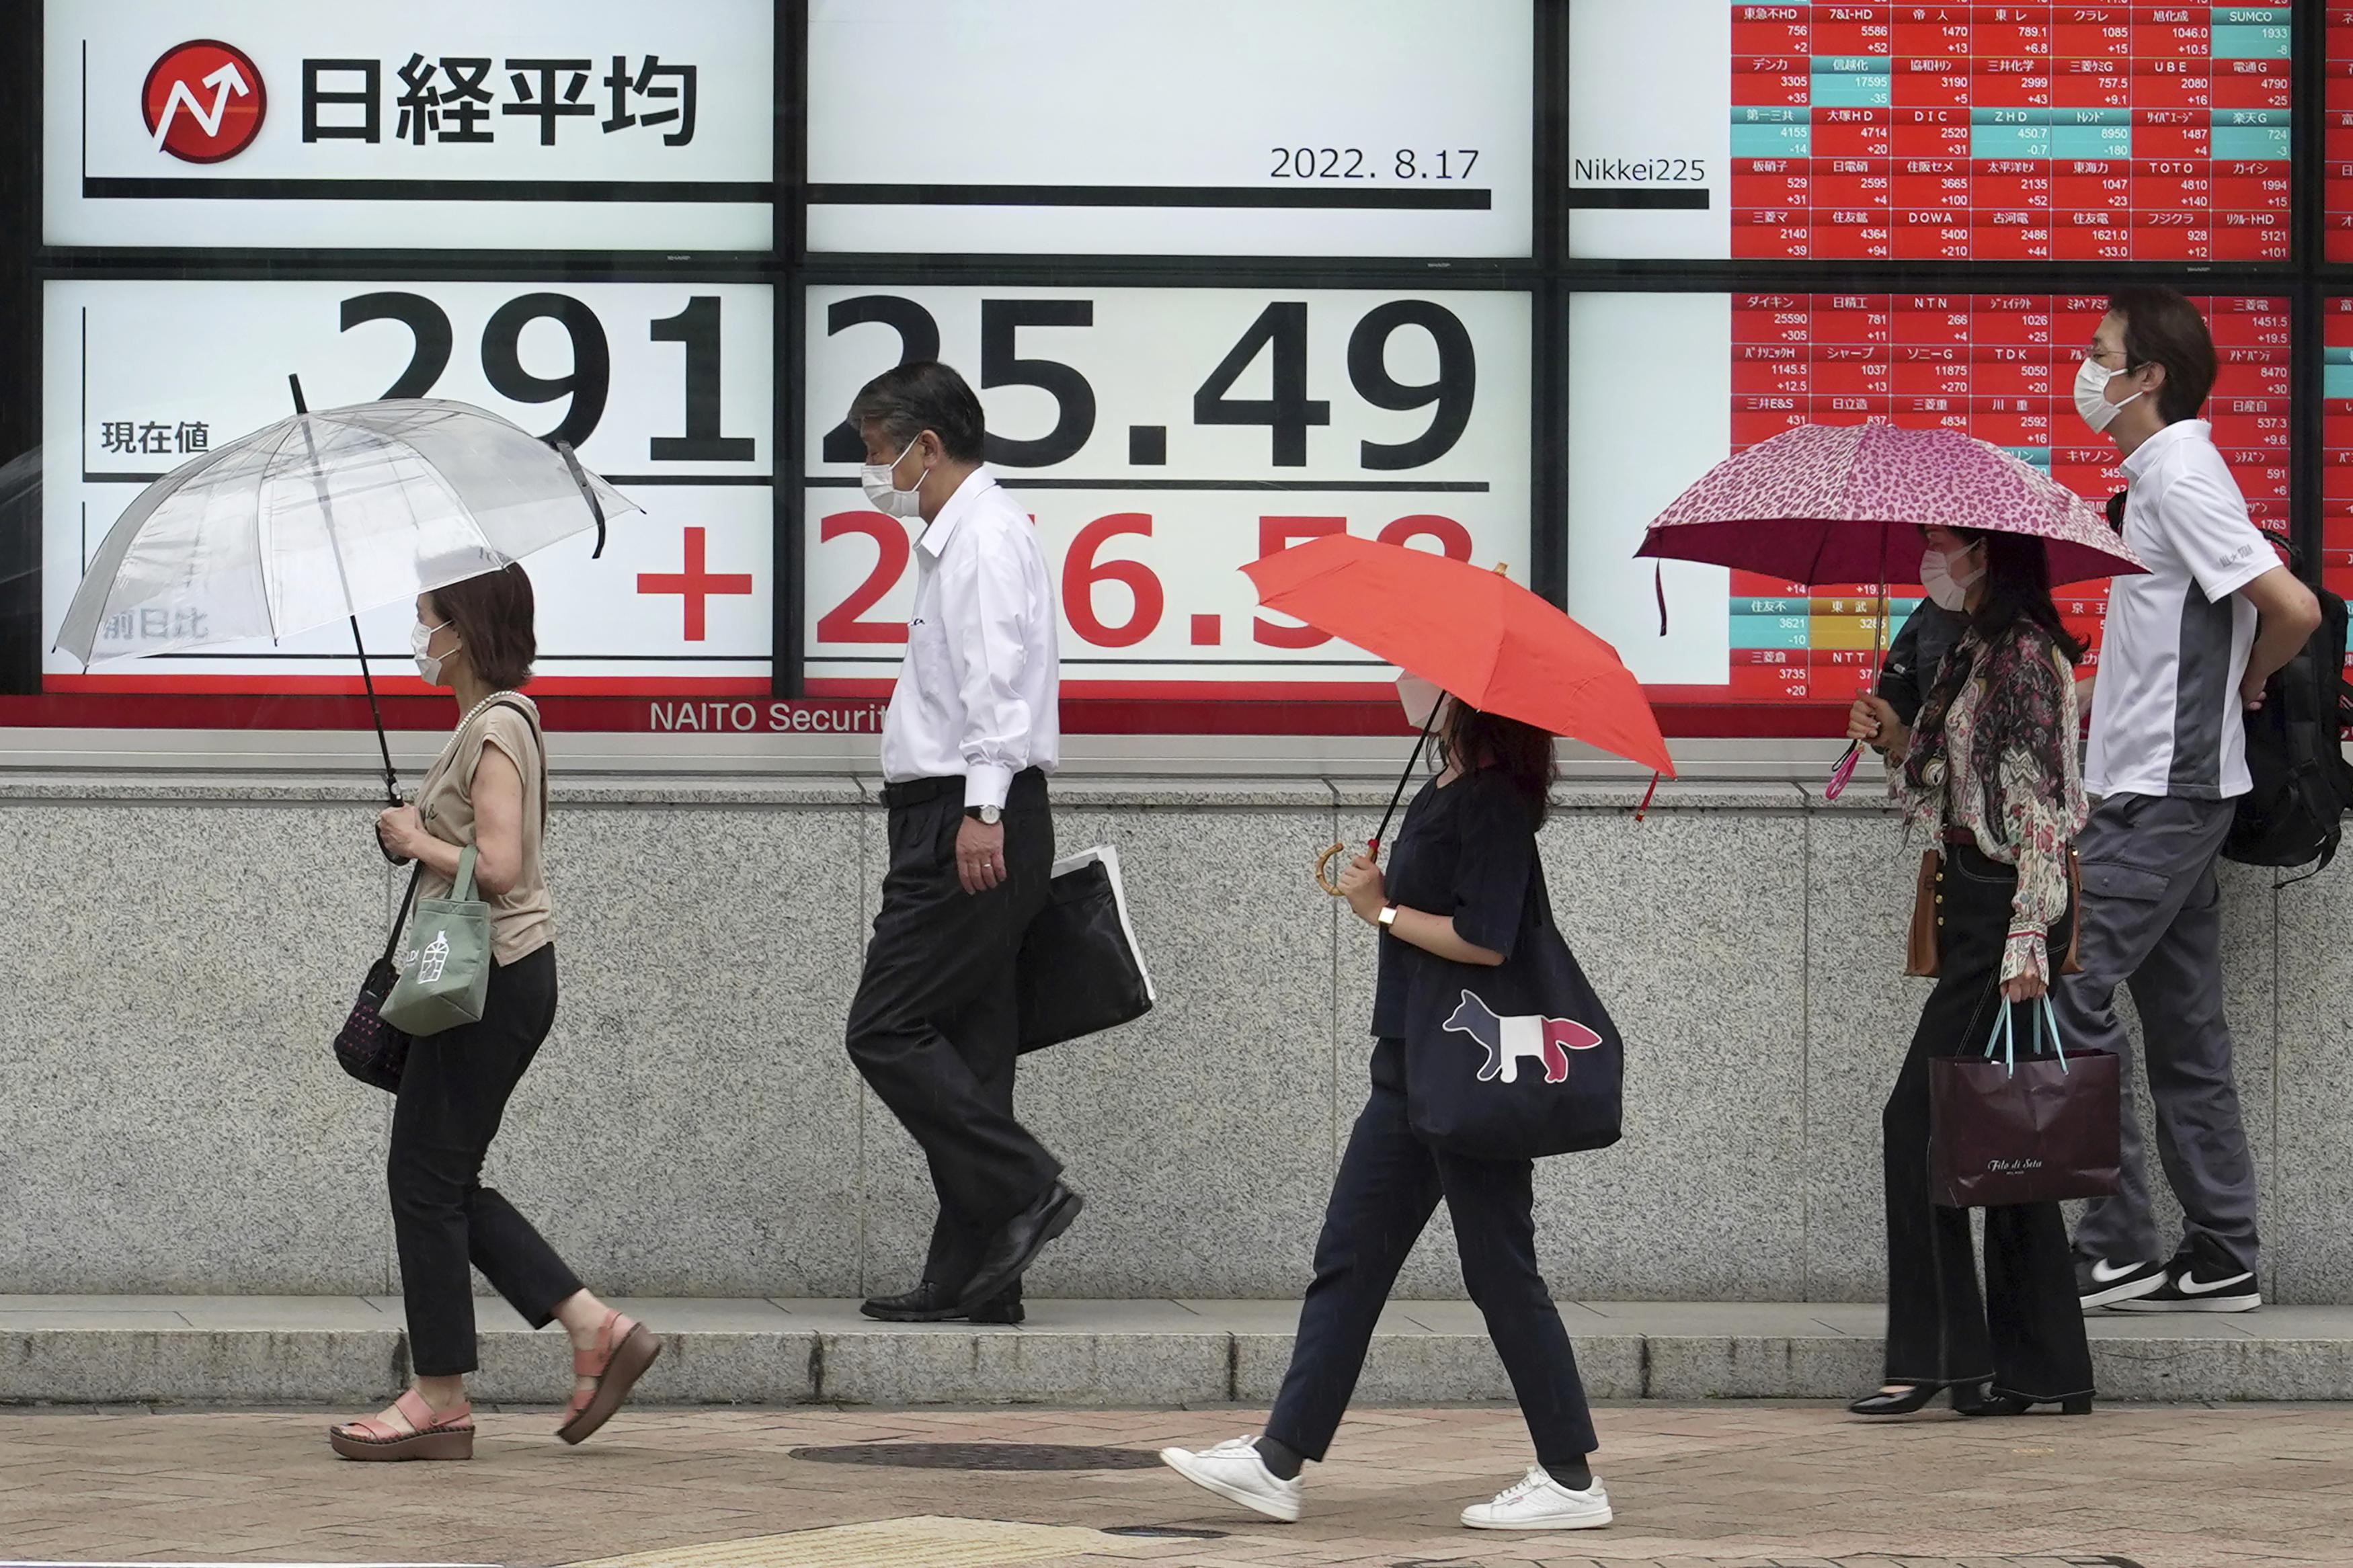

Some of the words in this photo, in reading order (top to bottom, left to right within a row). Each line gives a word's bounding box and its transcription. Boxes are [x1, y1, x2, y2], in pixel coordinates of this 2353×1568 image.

[1829, 8, 1873, 19] 7&I-HD
[2229, 10, 2272, 22] SUMCO
[1787, 25, 1808, 36] 756
[1861, 26, 1888, 36] 5586
[1942, 26, 1968, 37] 1470
[2018, 26, 2046, 37] 789.1
[2102, 27, 2128, 38] 1085
[2172, 27, 2208, 38] 1046.0
[2262, 28, 2288, 38] 1933
[1794, 42, 1808, 52] +2
[1868, 42, 1888, 53] +52
[1948, 42, 1968, 54] +13
[2024, 42, 2048, 54] +6.8
[2108, 43, 2128, 54] +15
[2178, 44, 2208, 55] +10.5
[1781, 76, 1808, 87] 3305
[1855, 76, 1888, 87] 17595
[1941, 77, 1968, 88] 3190
[2021, 77, 2048, 88] 2999
[2098, 77, 2128, 89] 757.5
[2181, 78, 2208, 89] 2080
[2261, 78, 2288, 89] 4790
[303, 53, 696, 146] 日経平均
[1787, 92, 1808, 104] +35
[1870, 93, 1888, 104] -35
[1954, 93, 1968, 104] +5
[2028, 93, 2048, 105] +43
[2104, 94, 2126, 105] +9.1
[2188, 94, 2208, 106] +16
[2268, 95, 2288, 106] +25
[1780, 126, 1808, 138] 4155
[1860, 127, 1887, 138] 4714
[1941, 127, 1968, 138] 2520
[2018, 128, 2048, 138] 450.7
[2101, 128, 2128, 139] 8950
[2182, 128, 2208, 140] 1487
[2268, 129, 2287, 140] 724
[1790, 143, 1808, 154] -14
[1867, 143, 1888, 155] +20
[1948, 144, 1966, 155] +31
[2027, 144, 2048, 155] -0.7
[2104, 145, 2128, 156] -180
[2194, 145, 2207, 156] +4
[1576, 159, 1704, 181] Nikkei225
[1787, 177, 1808, 189] 529
[1860, 177, 1888, 189] 2595
[1941, 178, 1968, 189] 3665
[2021, 178, 2048, 190] 2135
[2102, 179, 2128, 190] 1047
[2180, 179, 2208, 190] 4810
[2262, 179, 2287, 191] 1994
[1787, 194, 1806, 205] +31
[1874, 194, 1887, 205] +4
[1941, 195, 1968, 206] +100
[2028, 195, 2048, 206] +52
[2108, 196, 2128, 206] +23
[2181, 196, 2208, 206] +140
[2268, 196, 2288, 207] +15
[1909, 212, 1953, 223] DOWA
[1780, 228, 1807, 239] 2140
[1860, 229, 1887, 239] 4364
[1941, 229, 1968, 240] 5400
[2021, 229, 2048, 240] 2486
[2092, 229, 2128, 241] 1621.0
[2187, 230, 2208, 241] 928
[2261, 230, 2286, 241] 5121
[1787, 245, 1807, 256] +39
[1867, 245, 1887, 256] +94
[1941, 245, 1968, 257] +210
[2027, 246, 2047, 256] +44
[2098, 246, 2128, 257] +33.0
[2188, 247, 2208, 257] +12
[2261, 247, 2286, 258] +101
[1774, 313, 1808, 325] 25590
[1868, 314, 1886, 325] 781
[1947, 314, 1968, 325] 266
[2022, 315, 2048, 326] 1026
[2252, 317, 2288, 327] 1451.5
[1781, 330, 1807, 341] +305
[1868, 331, 1886, 341] +11
[1954, 331, 1968, 341] +4
[2028, 331, 2048, 342] +25
[2258, 333, 2287, 343] +19.5
[1771, 364, 1807, 375] 1145.5
[1862, 364, 1887, 376] 1037
[1935, 365, 1968, 376] 11875
[2021, 365, 2048, 376] 5050
[2260, 367, 2287, 378] 8470
[1777, 380, 1807, 392] +12.5
[1867, 381, 1887, 392] +13
[1940, 382, 1968, 393] +270
[2028, 382, 2048, 393] +20
[2268, 384, 2287, 395] +30
[1940, 415, 1967, 427] 4834
[2020, 416, 2047, 427] 2592
[2258, 417, 2287, 428] 537.3
[102, 422, 208, 453] 現在値
[2027, 433, 2047, 444] +16
[2264, 434, 2287, 445] +9.6
[2266, 468, 2286, 479] 591
[1786, 584, 1806, 594] +14
[1779, 618, 1805, 628] 3621
[1788, 634, 1806, 645] -10
[1779, 668, 1806, 679] 3735
[1786, 685, 1806, 696] +20
[650, 702, 757, 731] NAITO
